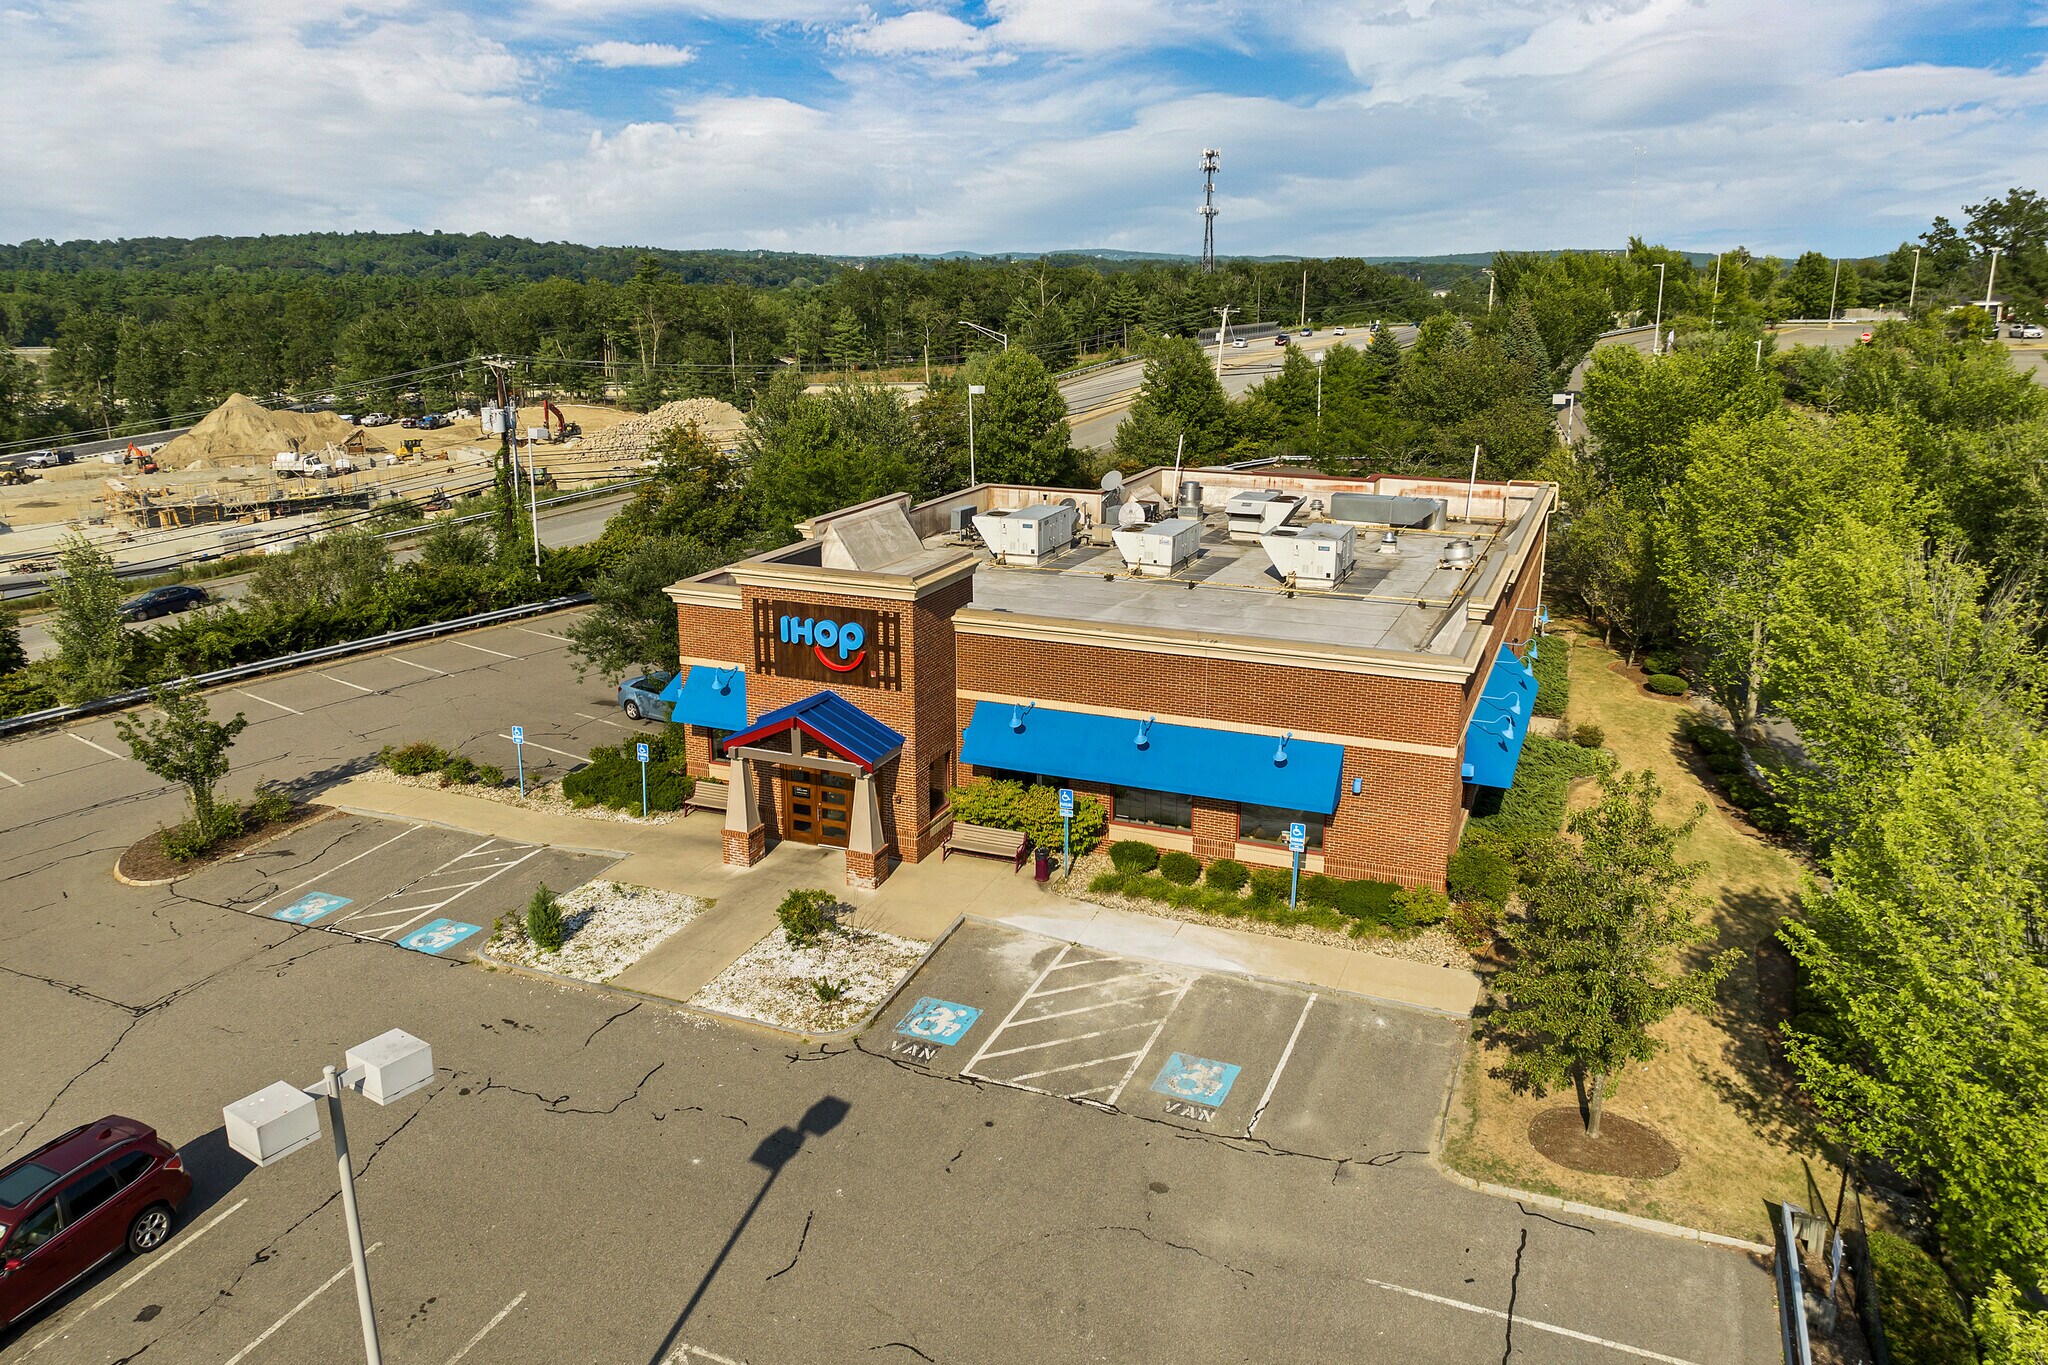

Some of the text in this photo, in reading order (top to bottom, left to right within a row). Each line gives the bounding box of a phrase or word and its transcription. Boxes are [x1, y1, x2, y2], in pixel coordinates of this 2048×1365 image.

[780, 615, 866, 659] IHOP
[891, 1040, 936, 1060] VAN
[1165, 1101, 1216, 1122] VAN
